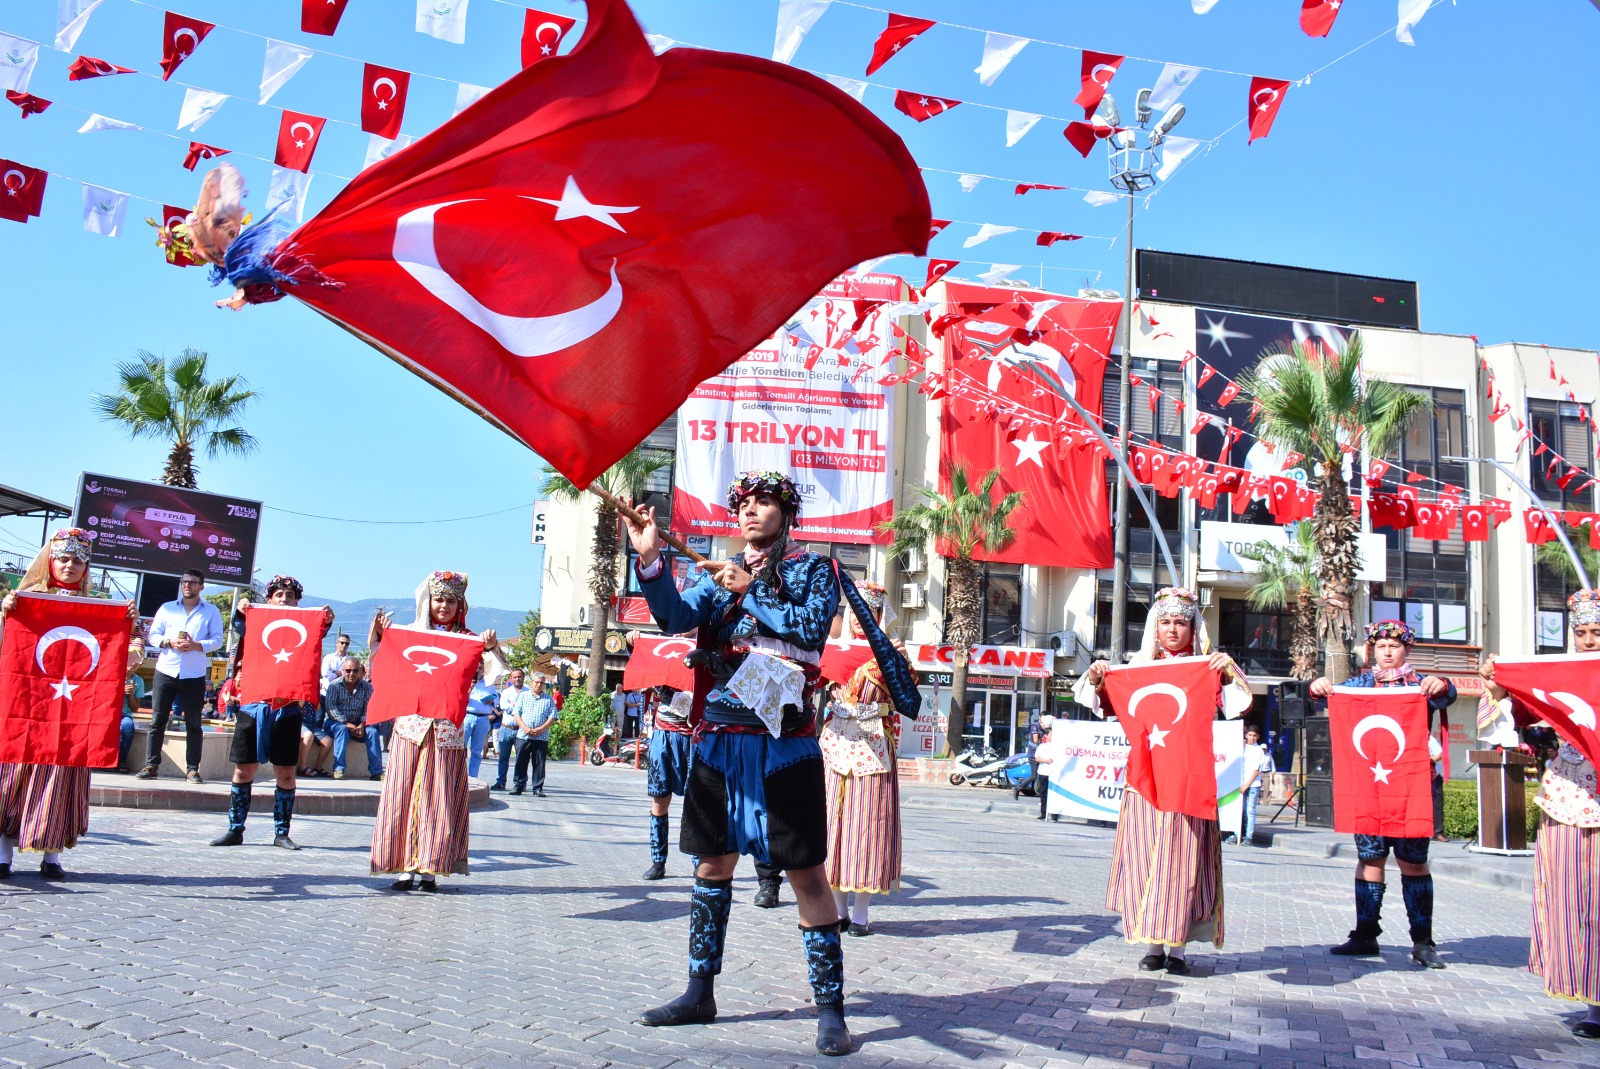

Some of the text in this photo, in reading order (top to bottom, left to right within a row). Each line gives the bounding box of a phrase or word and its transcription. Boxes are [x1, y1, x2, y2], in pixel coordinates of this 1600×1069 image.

[746, 351, 775, 361] 2019
[781, 353, 805, 363] Yılla
[751, 366, 805, 378] Yönetilen
[695, 388, 729, 398] Tanıtım,
[765, 390, 796, 400] Temsili
[797, 393, 837, 404] Ağırlama
[851, 397, 879, 406] Yemek
[741, 402, 793, 412] Giderlerinin
[688, 419, 717, 442] 13
[852, 428, 887, 451] TL
[795, 454, 812, 464] (13
[862, 457, 880, 469] TL)
[168, 513, 187, 521] EYLÜL
[534, 513, 546, 542] CHP
[691, 519, 724, 528] BUNLARI
[828, 526, 875, 536] SUNUYORUZ
[170, 542, 190, 550] 21:00
[688, 536, 707, 545] CHP
[1093, 735, 1101, 745] 7
[1213, 753, 1226, 762] UN
[1085, 764, 1124, 782] 97. Y
[1097, 785, 1124, 800] KUT
